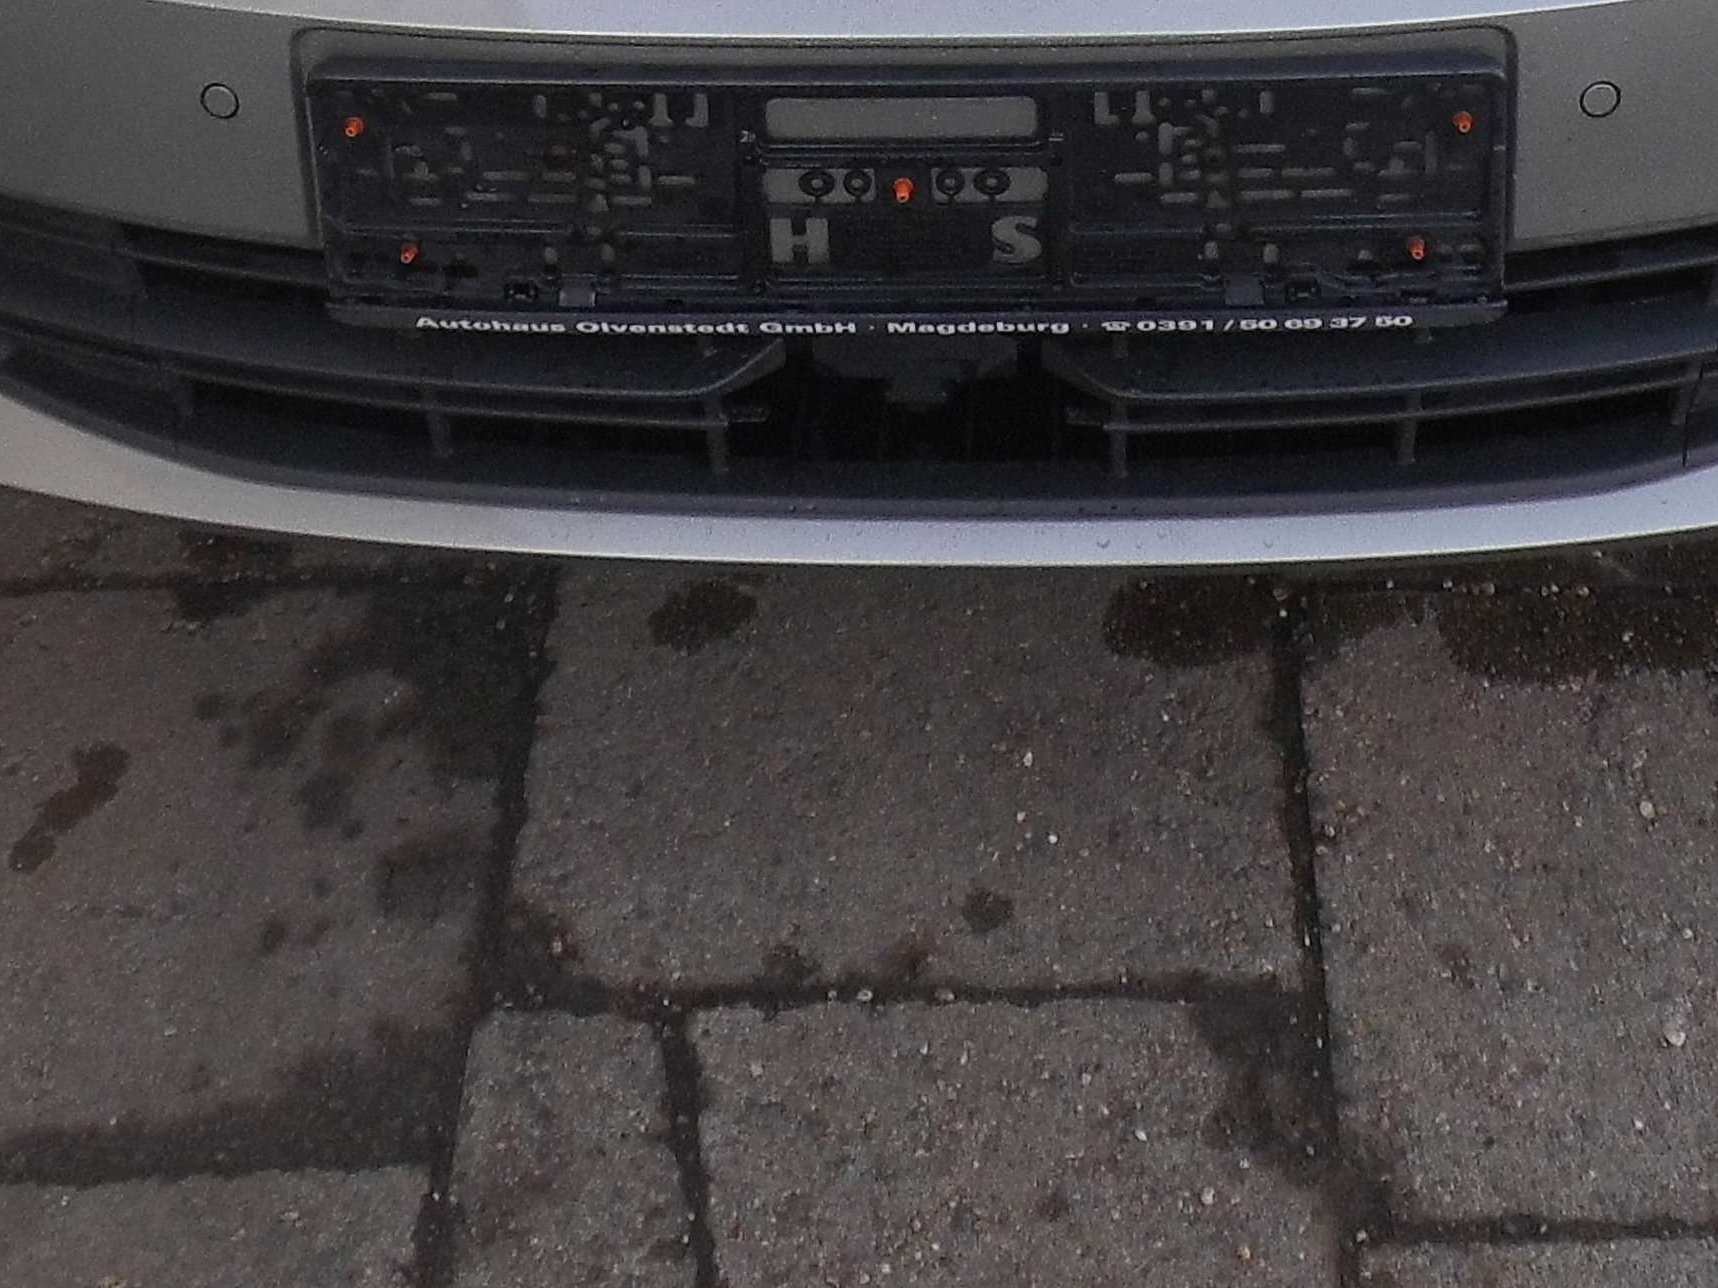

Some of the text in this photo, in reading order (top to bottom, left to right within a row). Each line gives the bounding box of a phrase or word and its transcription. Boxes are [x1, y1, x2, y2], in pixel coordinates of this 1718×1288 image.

[415, 316, 566, 334] Autohaus
[575, 320, 750, 335] Olvenstedt
[758, 321, 857, 335] GmbH
[886, 321, 1070, 335] Magdeburg
[1329, 315, 1367, 329] 37
[1374, 314, 1414, 328] 50
